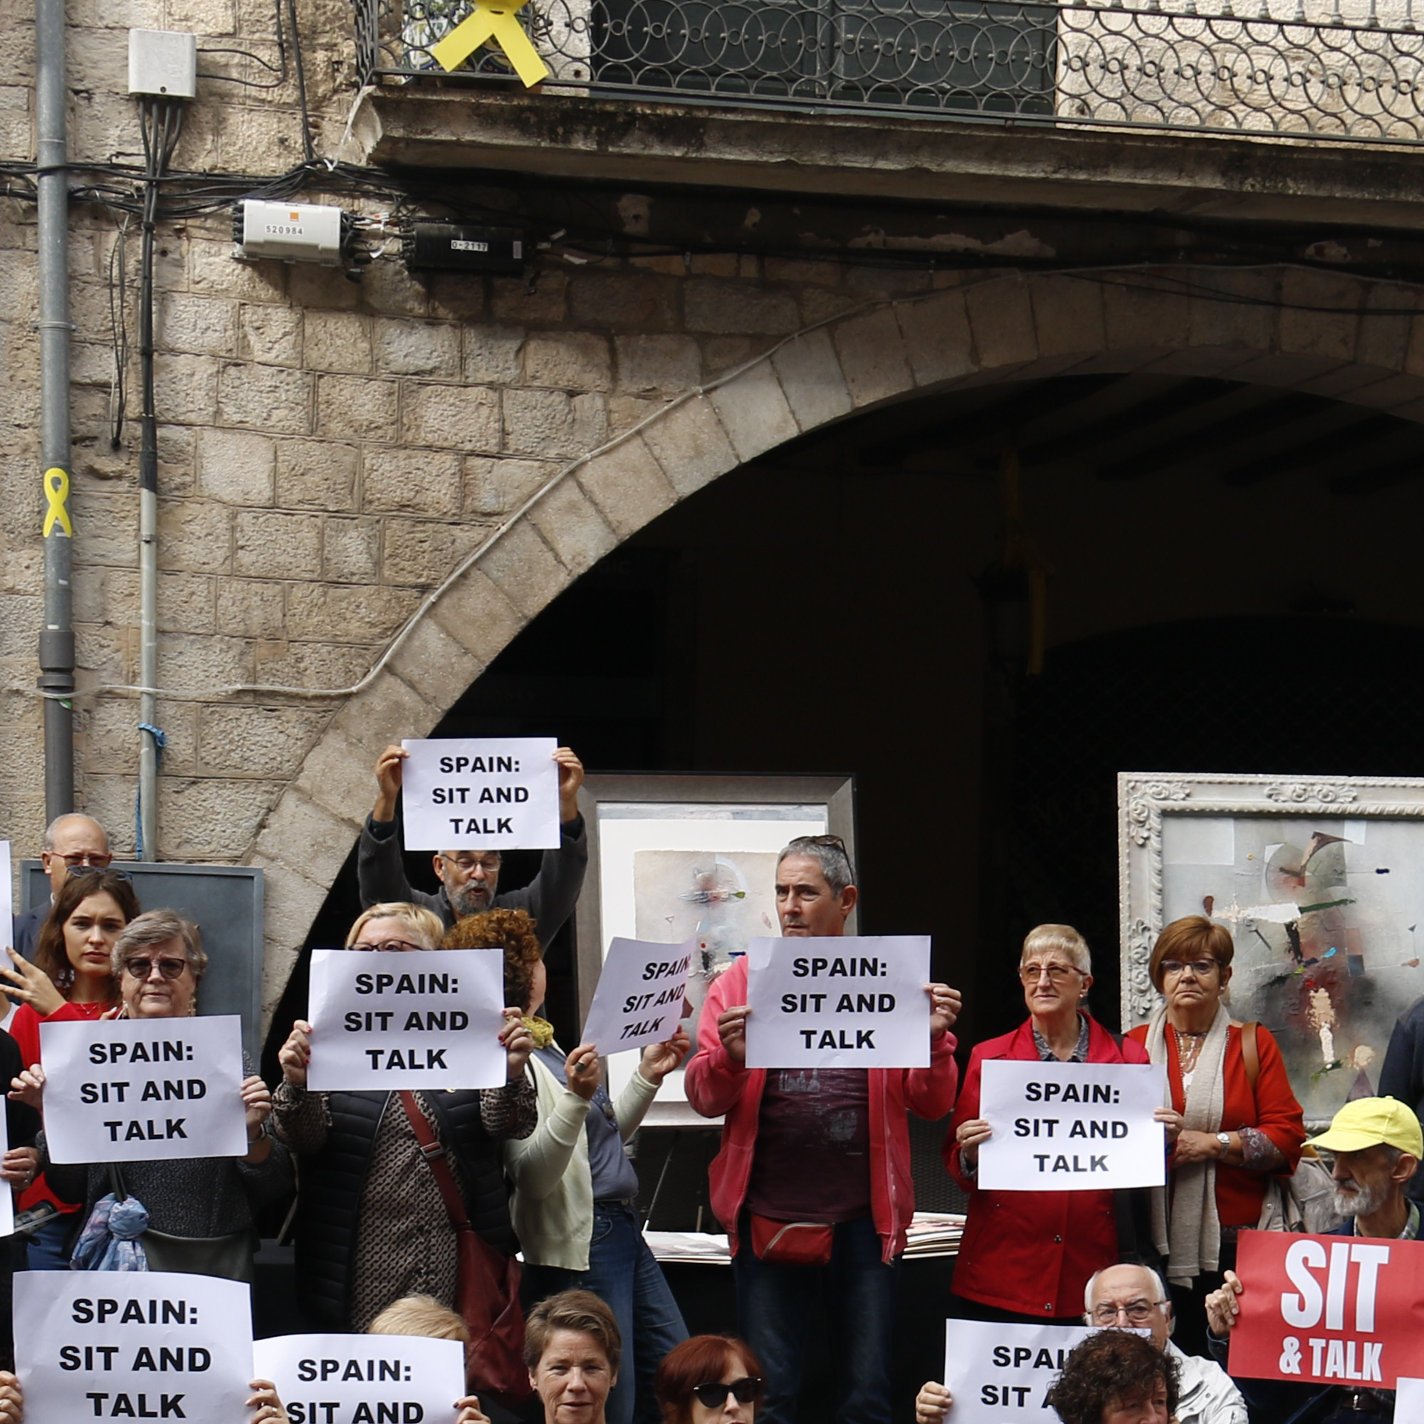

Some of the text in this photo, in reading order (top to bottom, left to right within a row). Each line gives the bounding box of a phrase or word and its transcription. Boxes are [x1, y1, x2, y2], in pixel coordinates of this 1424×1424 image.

[265, 224, 304, 235] 520984
[440, 757, 519, 773] SPAIN:
[433, 787, 528, 804] SIT AND
[450, 818, 512, 834] TALK
[793, 958, 886, 977] SPAIN:
[356, 974, 458, 994] SPAIN:
[623, 983, 685, 1013] SIT AND
[781, 994, 895, 1013] SIT AND
[344, 1012, 468, 1032] SIT AND
[620, 1017, 664, 1039] TALK
[800, 1030, 875, 1049] TALK
[90, 1041, 193, 1064] SPAIN:
[366, 1049, 447, 1070] TALK
[81, 1079, 206, 1103] SIT AND
[1026, 1082, 1119, 1103] SPAIN:
[104, 1119, 187, 1141] TALK
[1014, 1118, 1128, 1138] SIT AND
[1034, 1155, 1108, 1172] TALK
[1281, 1239, 1390, 1332] SIT
[72, 1299, 197, 1324] SPAIN:
[59, 1346, 211, 1372] SIT AND
[1279, 1337, 1383, 1382] & TALK
[298, 1359, 410, 1381] SPAIN:
[86, 1393, 186, 1418] TALK
[981, 1385, 1031, 1407] SIT
[286, 1402, 423, 1424] SIT AND
